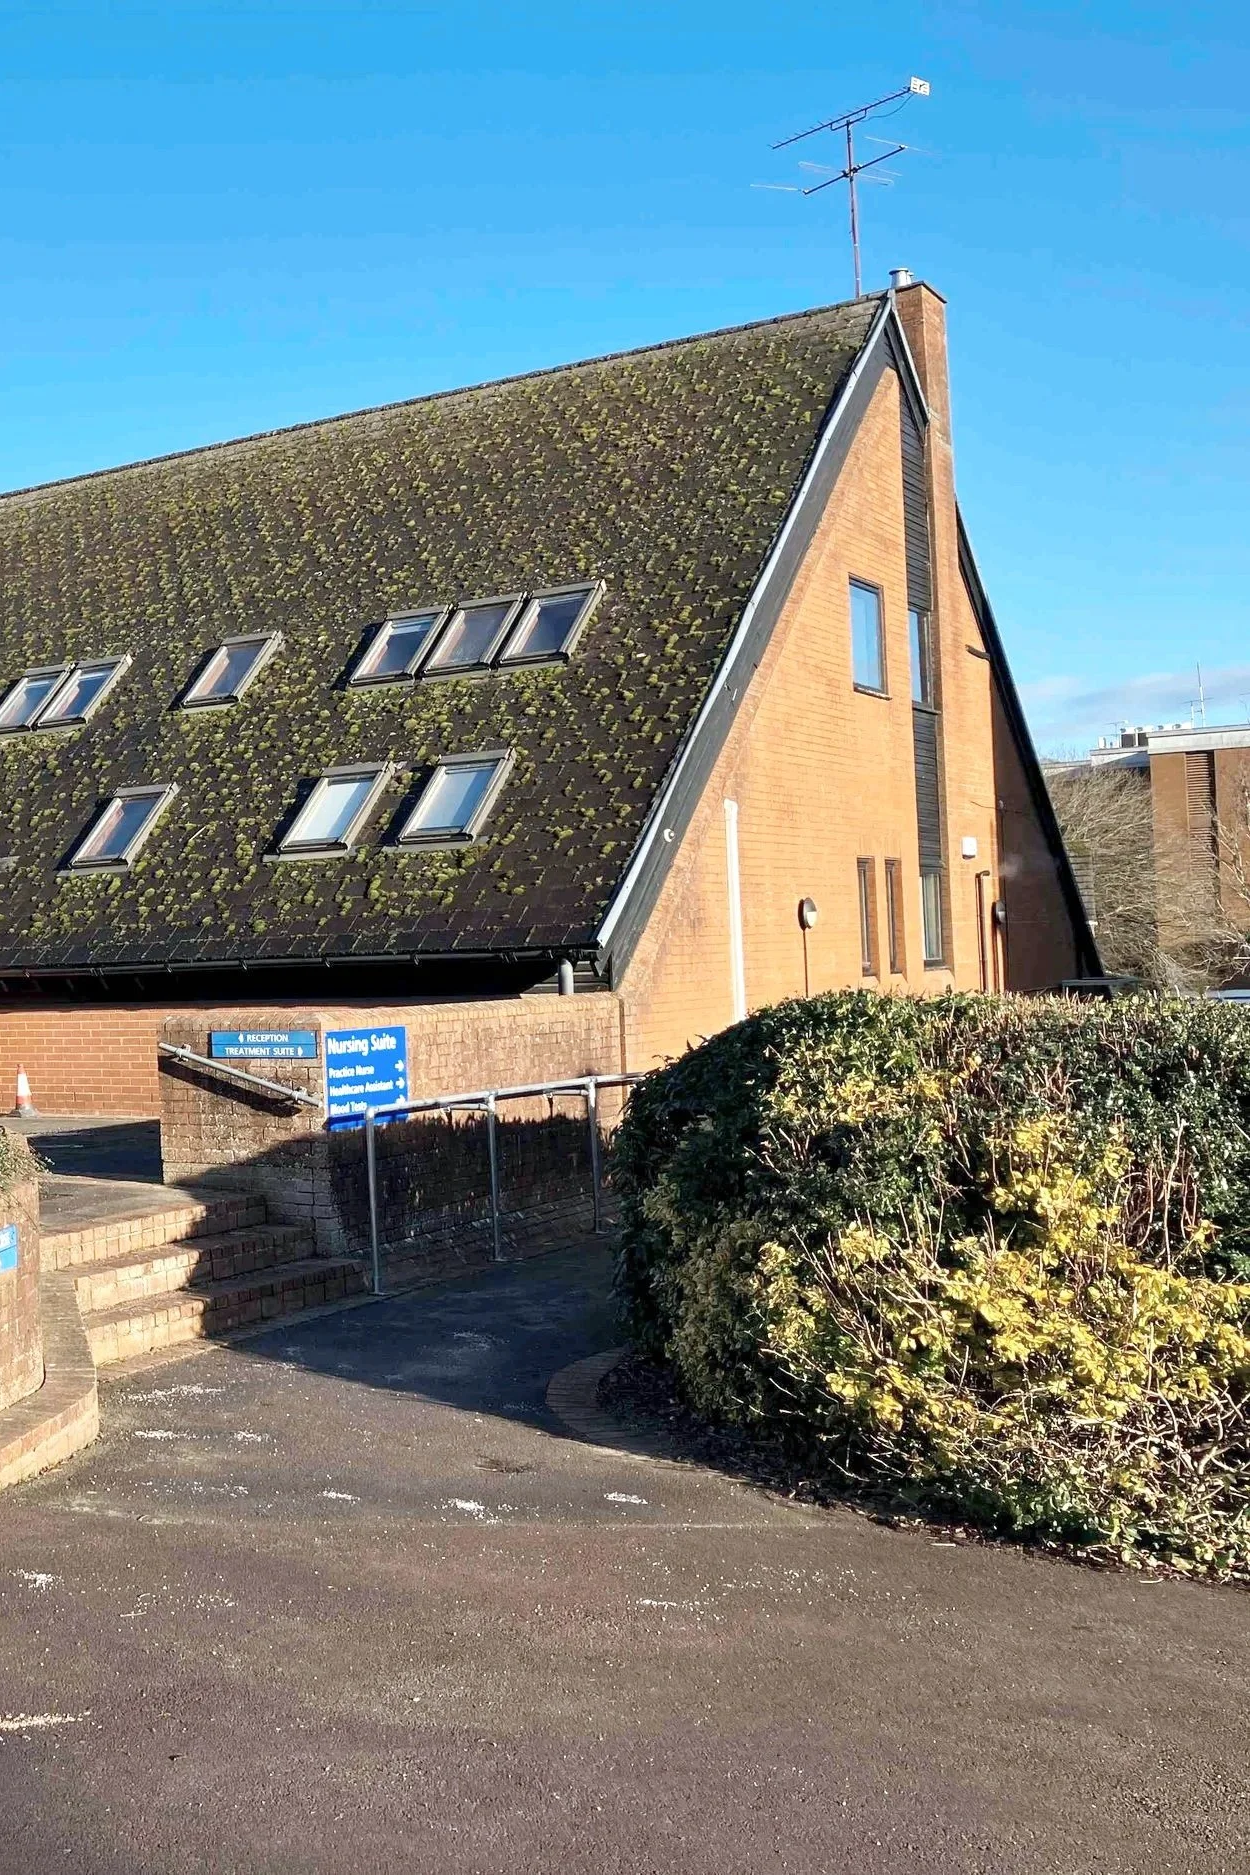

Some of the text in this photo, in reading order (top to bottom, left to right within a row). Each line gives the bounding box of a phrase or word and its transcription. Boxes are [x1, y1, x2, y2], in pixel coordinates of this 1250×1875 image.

[246, 1033, 289, 1043] RECEPTION
[327, 1033, 397, 1057] Nursing Suite
[225, 1047, 295, 1056] TREATMENT SUITE
[328, 1065, 375, 1079] Practice Nurse
[329, 1080, 394, 1097] Healthcare Assistant
[330, 1102, 350, 1116] Blood
